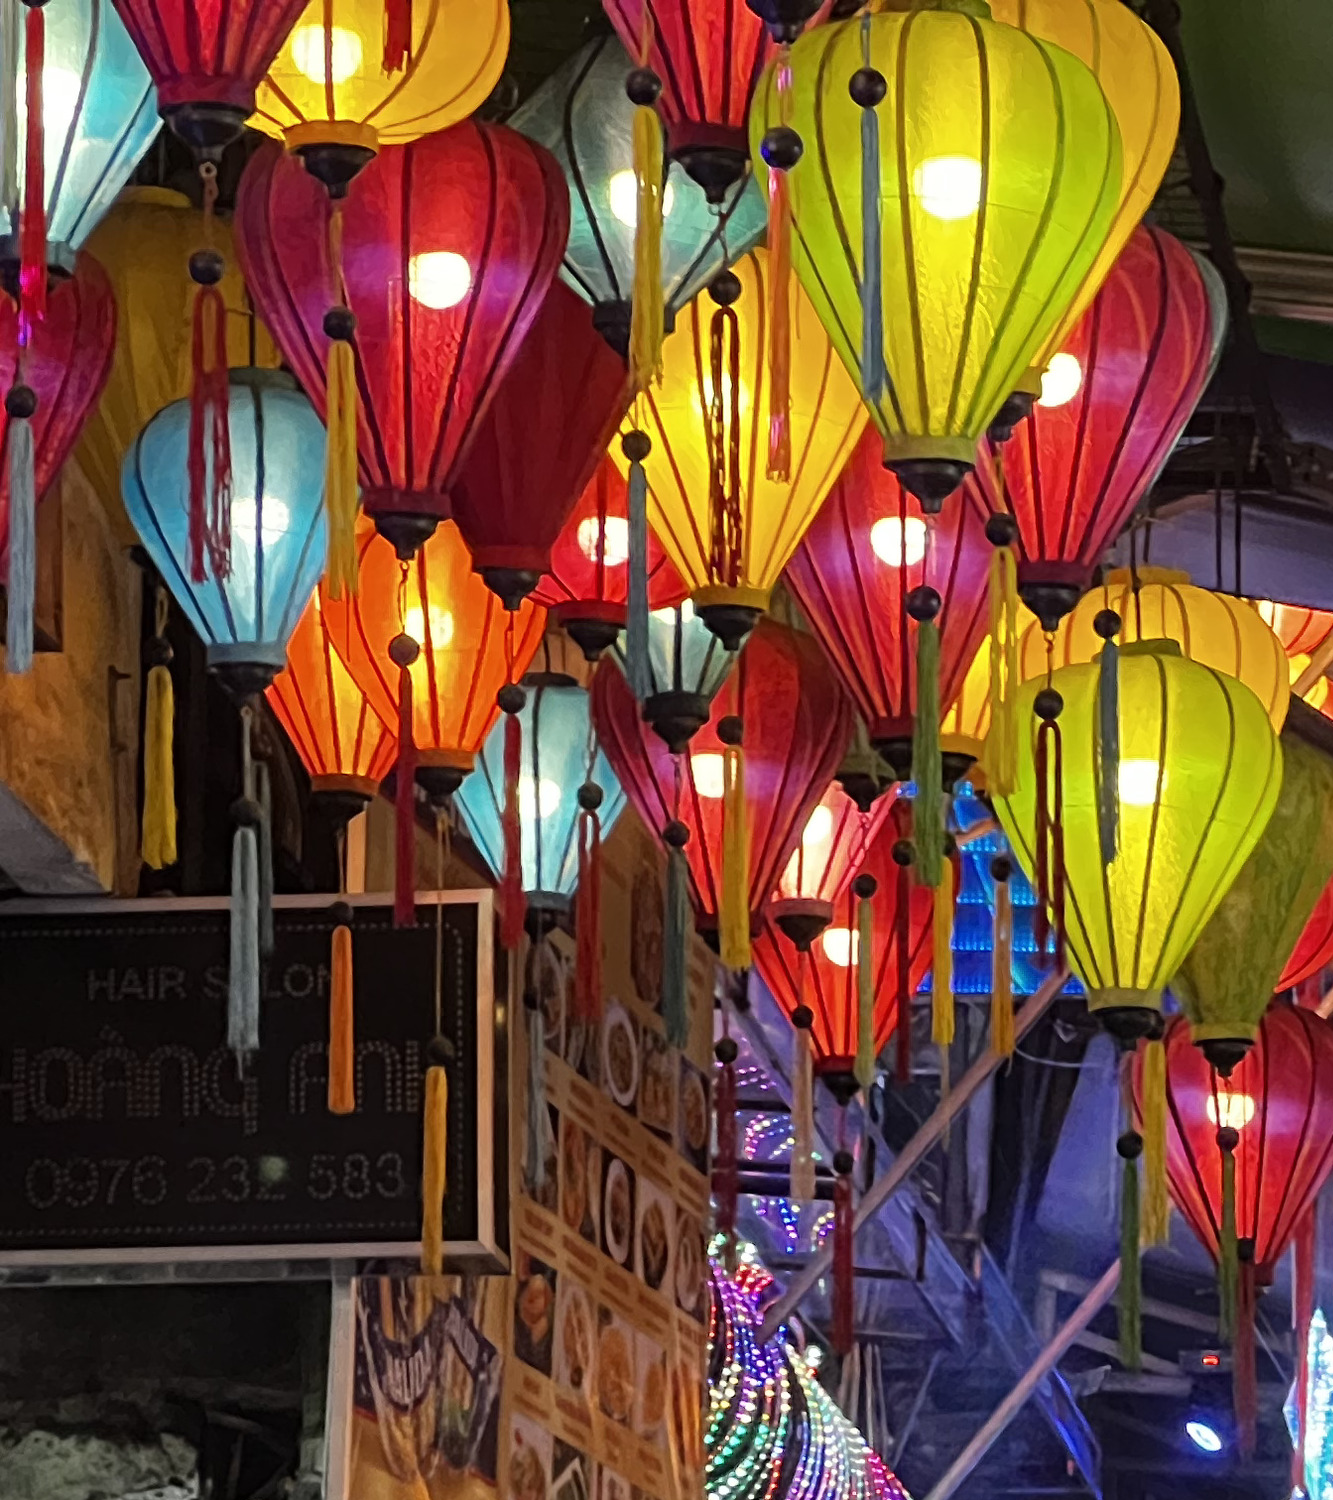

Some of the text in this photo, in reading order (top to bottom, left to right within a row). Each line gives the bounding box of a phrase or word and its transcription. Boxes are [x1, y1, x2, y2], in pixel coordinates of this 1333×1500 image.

[86, 962, 332, 1002] HAIR SLO
[25, 1153, 169, 1210] 0976
[307, 1152, 406, 1201] 583
